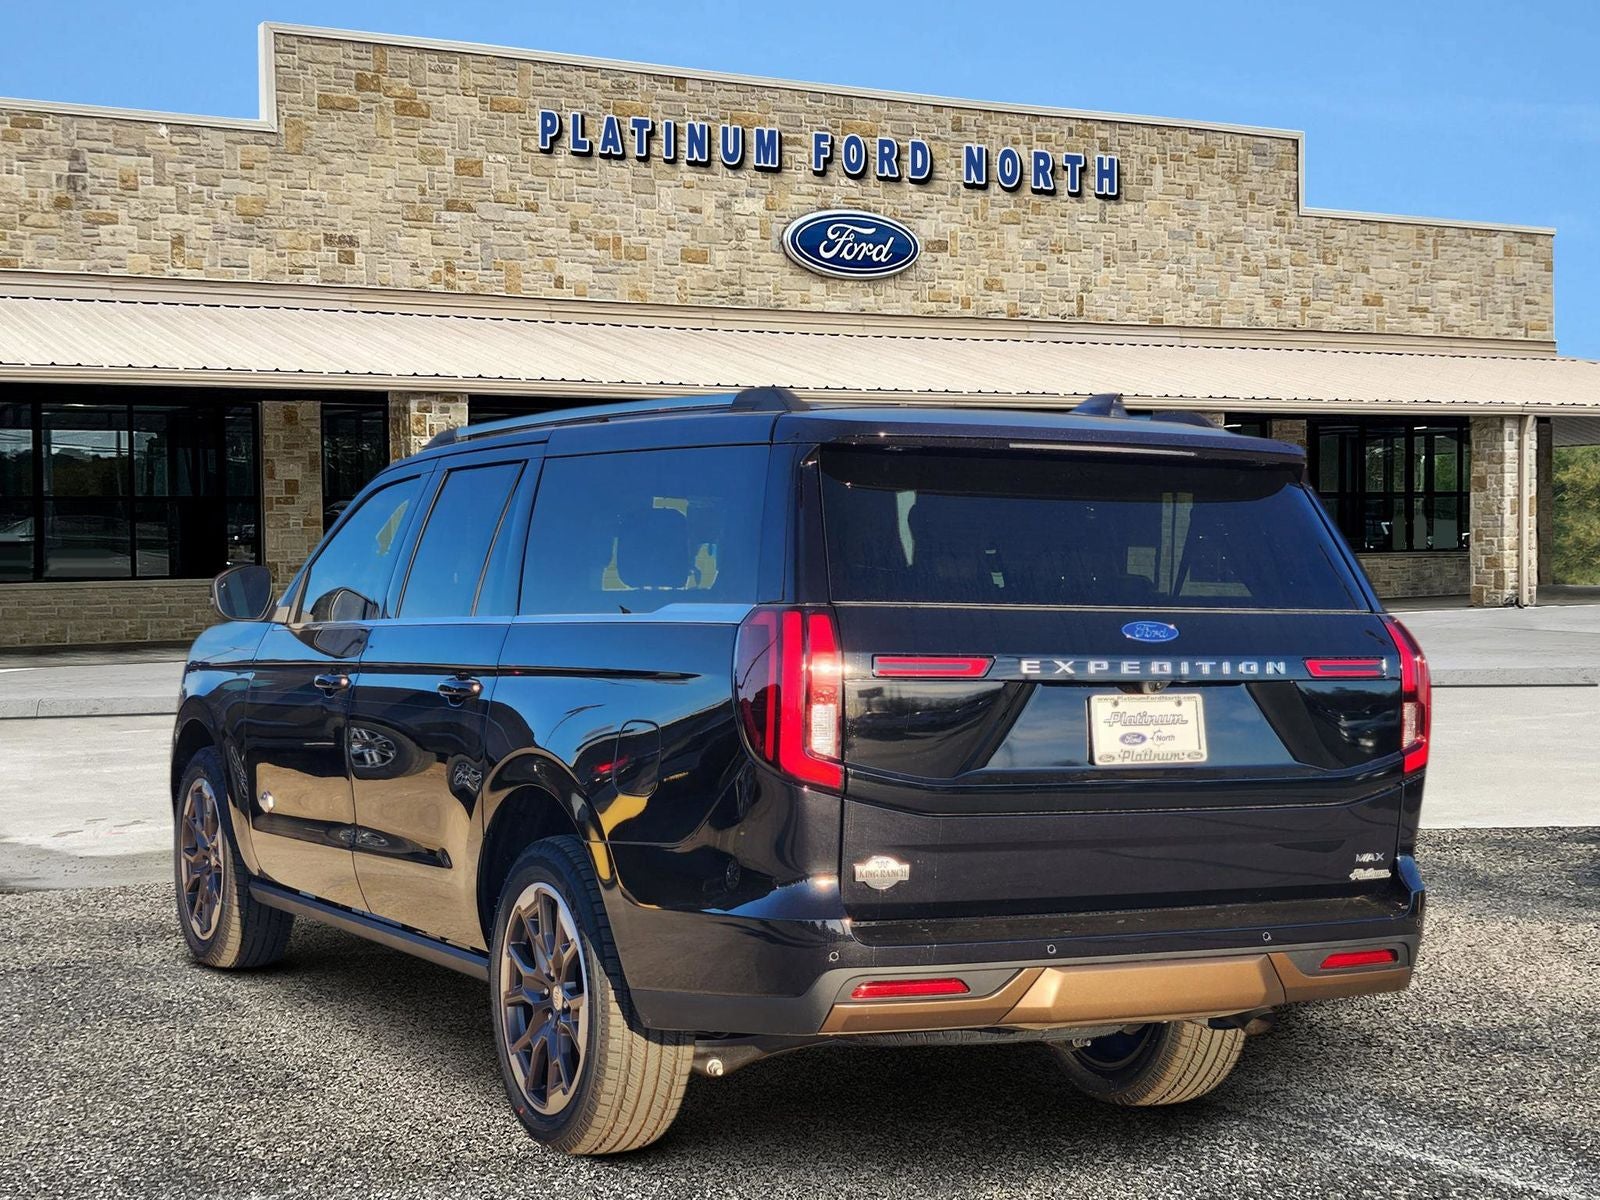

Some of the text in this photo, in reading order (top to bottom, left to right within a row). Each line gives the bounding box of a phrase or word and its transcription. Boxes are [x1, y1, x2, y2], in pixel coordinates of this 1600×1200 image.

[538, 110, 1121, 199] PLATINUM FORD NORTH
[818, 222, 895, 265] Ford
[1134, 623, 1169, 639] Ford
[1020, 660, 1287, 675] EXPEDITION
[1104, 711, 1188, 727] Platinum
[1156, 734, 1176, 742] North
[1120, 749, 1185, 763] Platinum
[1355, 852, 1385, 862] MAX
[859, 868, 907, 878] KING RANCH
